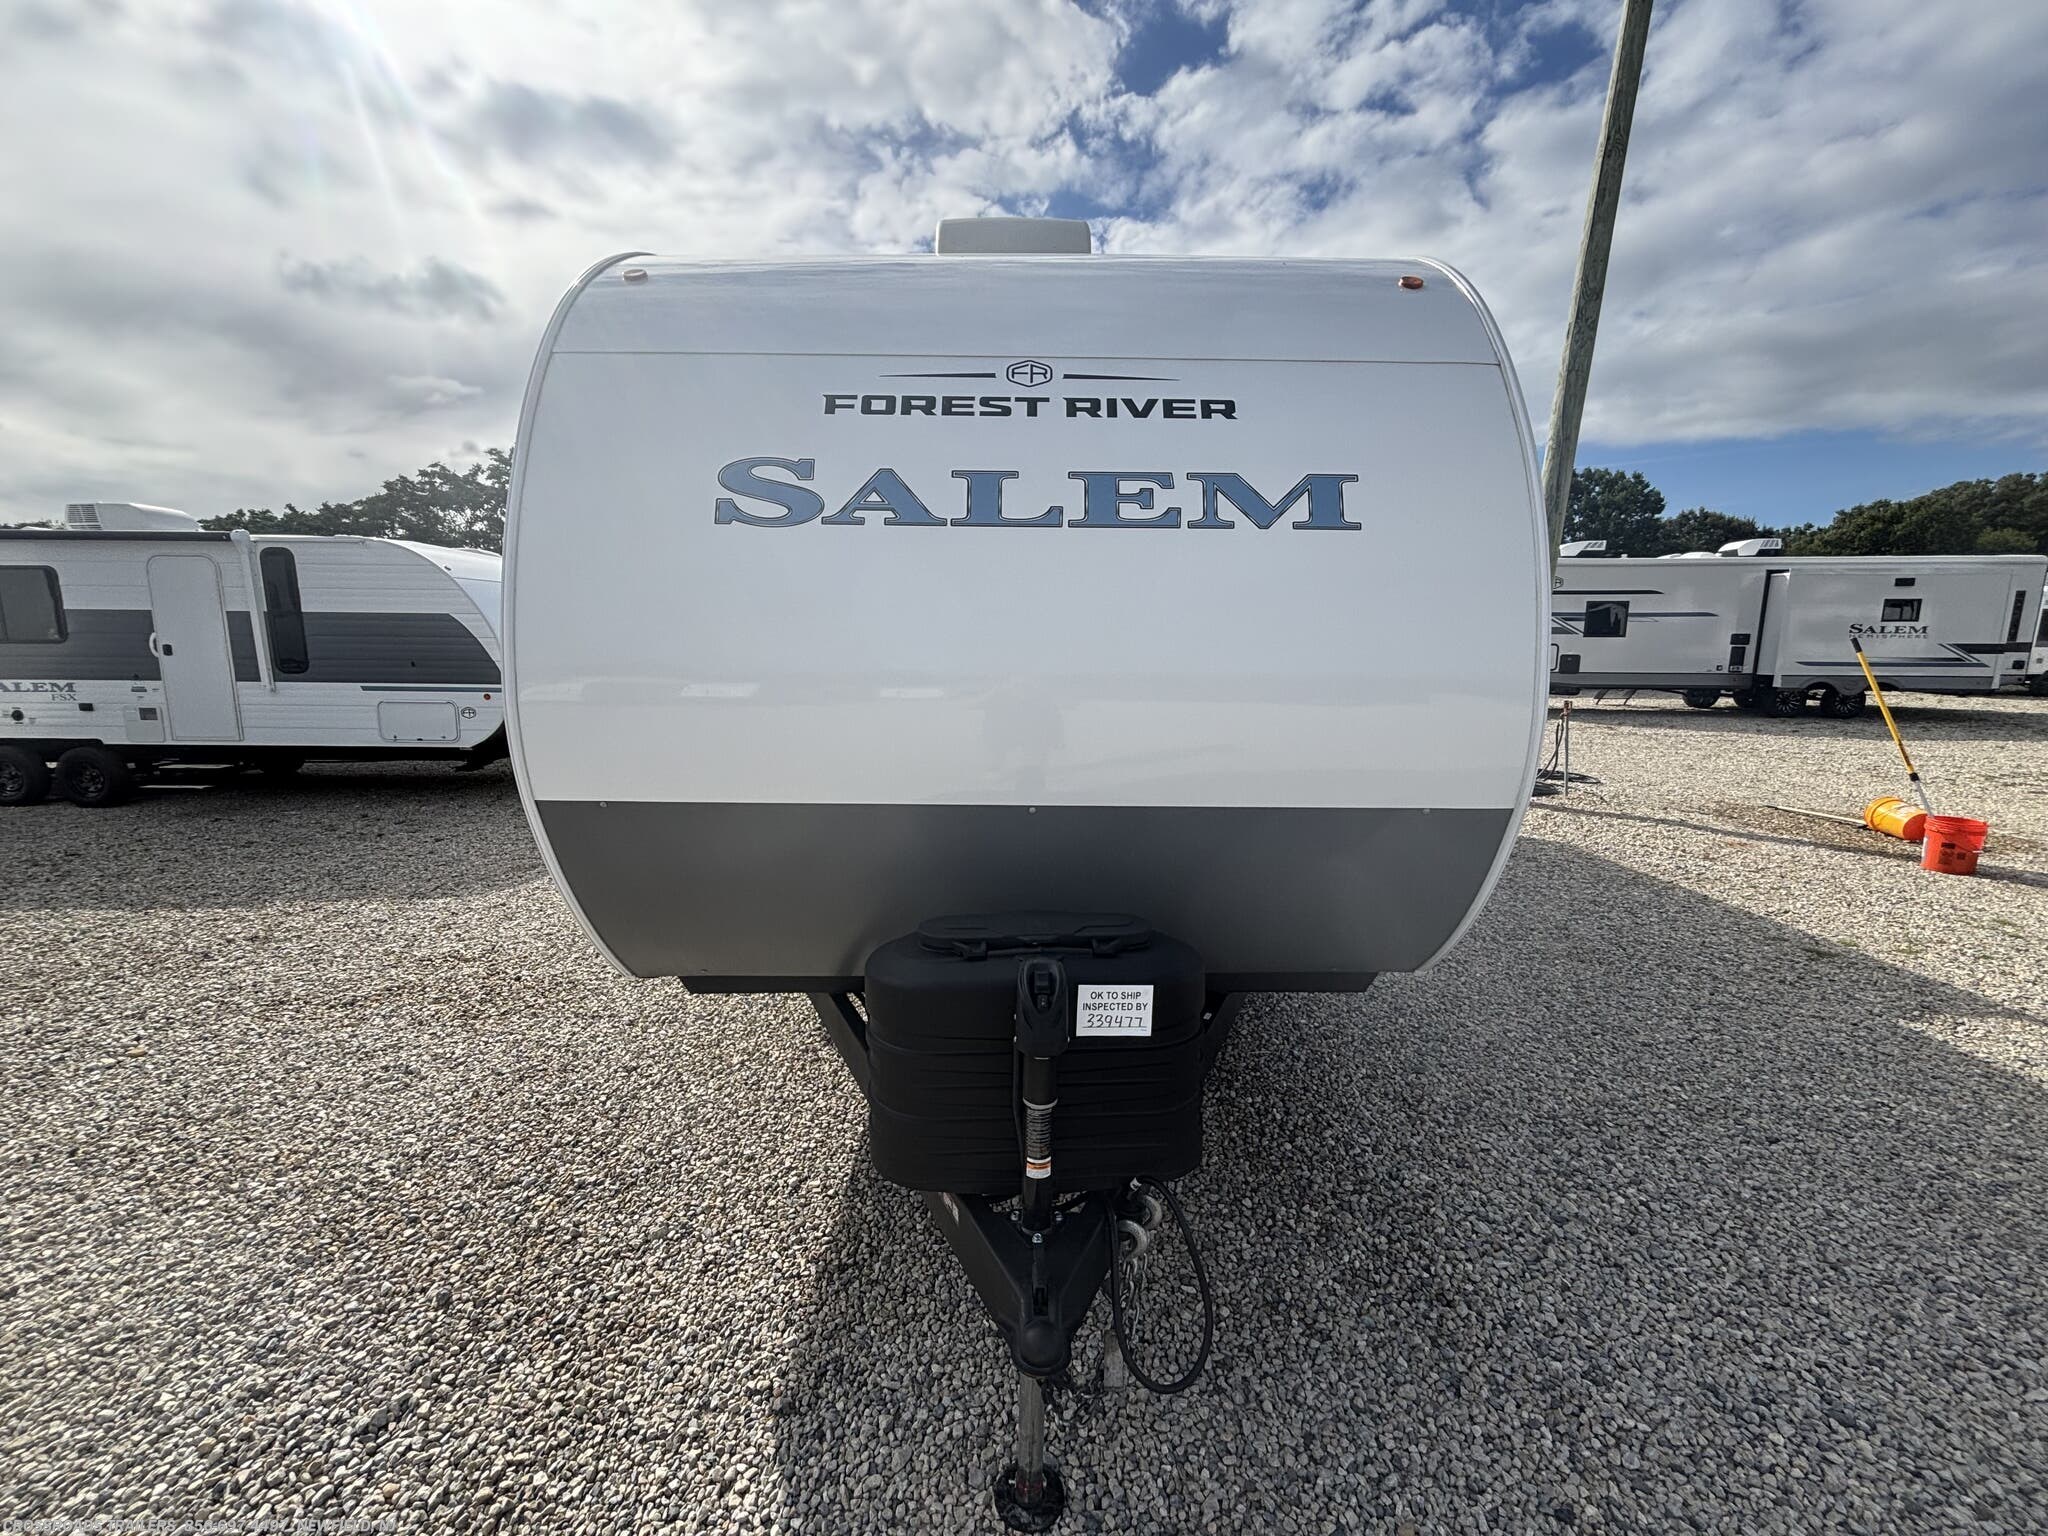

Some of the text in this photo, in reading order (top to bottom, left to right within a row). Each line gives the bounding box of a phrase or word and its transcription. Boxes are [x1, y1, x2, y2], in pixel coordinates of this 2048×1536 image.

[823, 394, 1239, 420] FOREST RIVER
[714, 456, 1363, 531] SALEM
[1848, 623, 1929, 634] SALEM
[51, 693, 77, 701] FSX
[1090, 991, 1142, 1000] OK TO SHIP
[1082, 1002, 1149, 1011] INSPECTED BY
[1087, 1013, 1143, 1028] 339477
